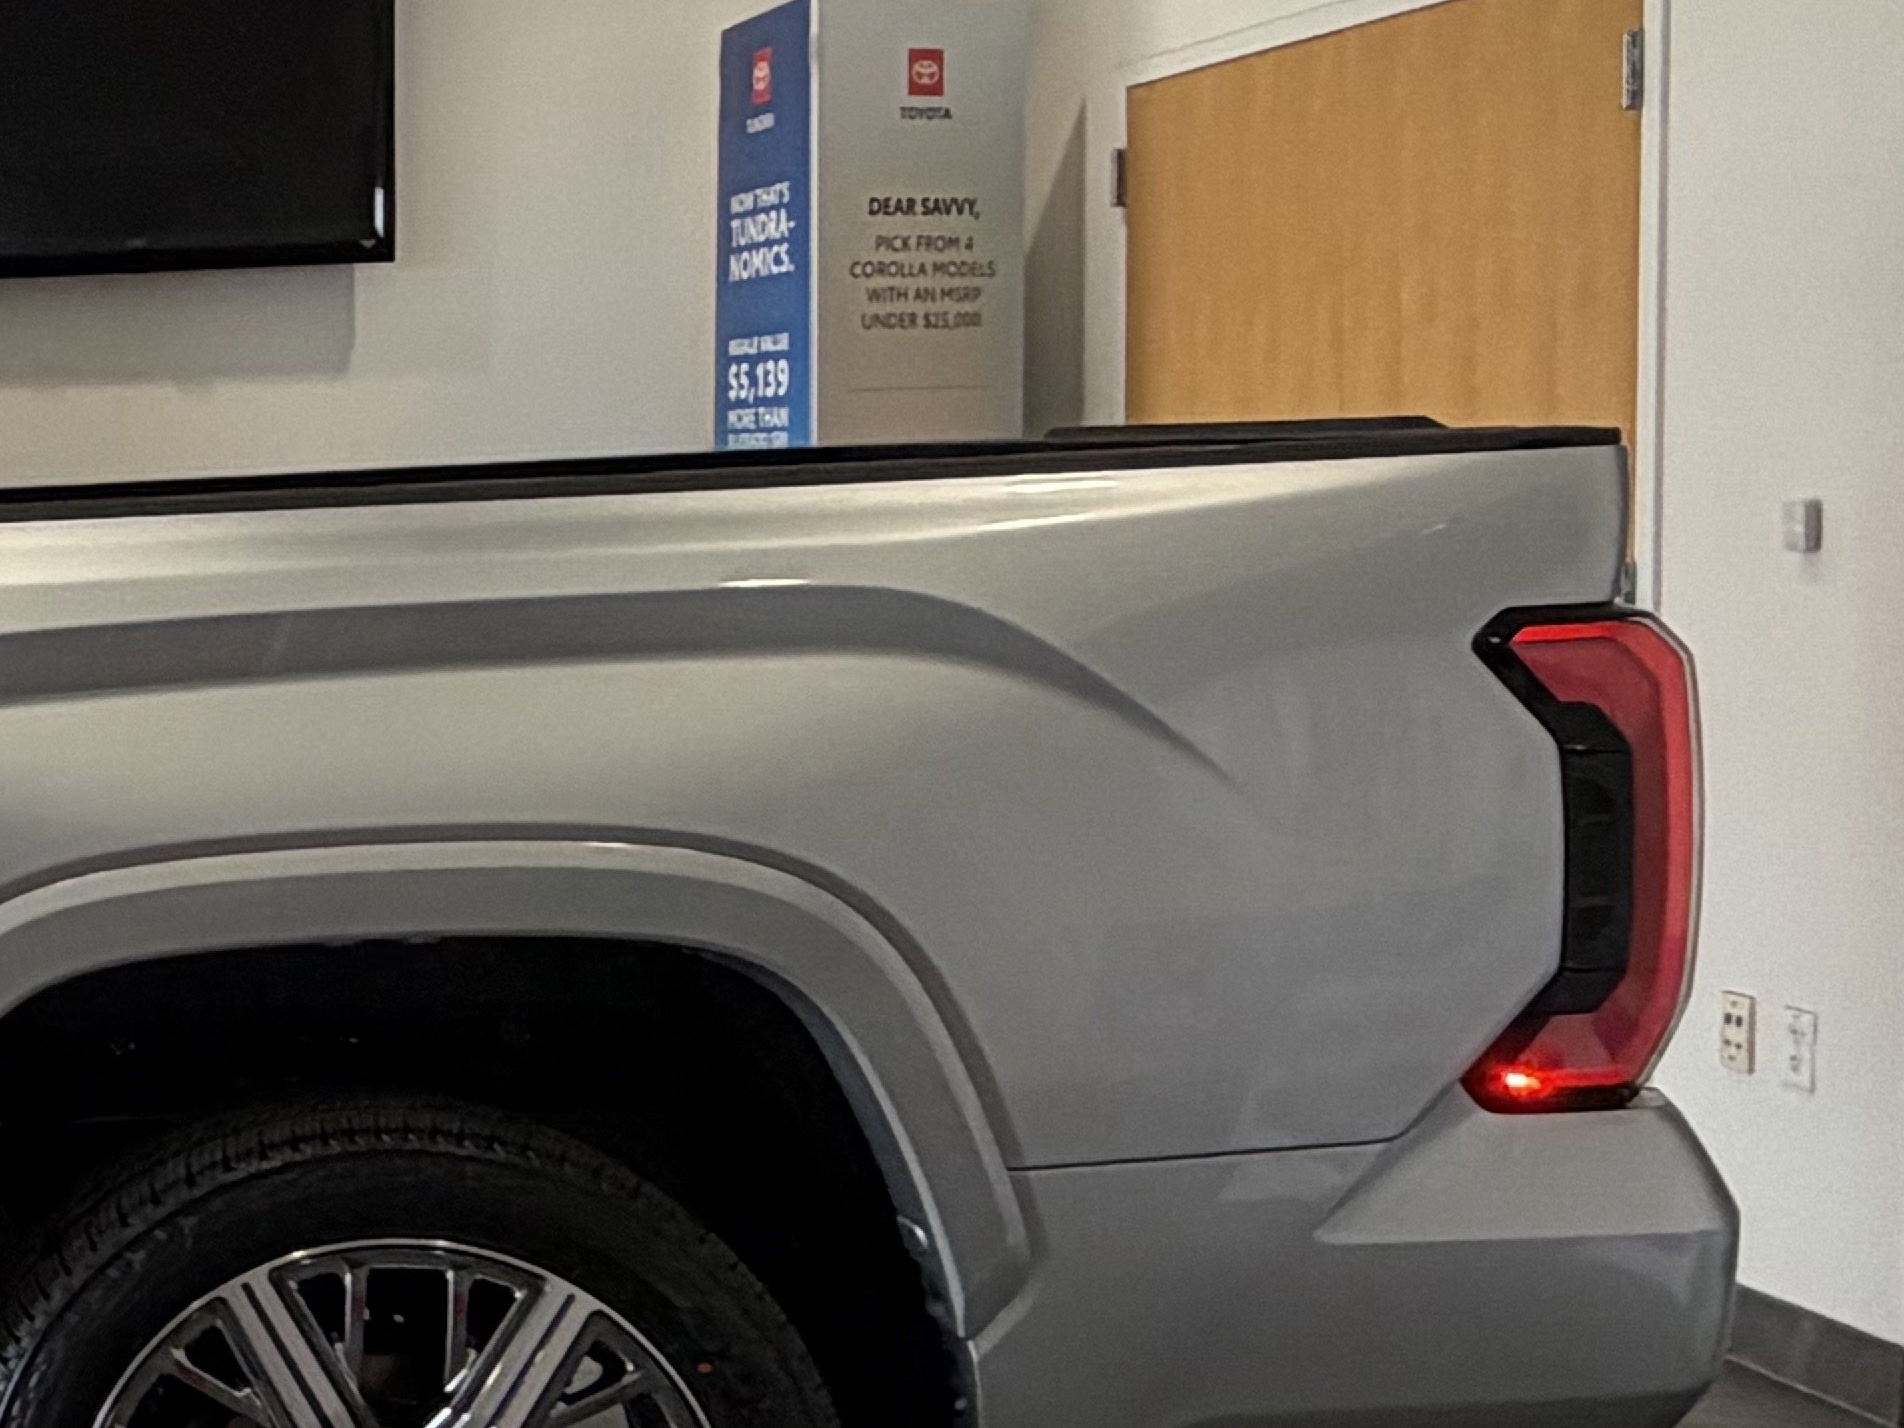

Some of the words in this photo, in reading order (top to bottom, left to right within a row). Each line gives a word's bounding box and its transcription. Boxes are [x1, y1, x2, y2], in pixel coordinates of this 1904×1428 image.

[899, 106, 953, 120] TOYOTA
[868, 196, 917, 217] DEAR
[920, 196, 981, 221] SAVVY,
[730, 208, 796, 248] TUNDRA-
[874, 234, 912, 253] PICK
[915, 234, 961, 253] FROM
[729, 242, 795, 283] NOMICS.
[848, 260, 928, 280] COROLLA
[931, 260, 997, 279] MODELS
[865, 286, 910, 304] WITH
[913, 286, 938, 304] AN
[861, 311, 918, 330] UNDER
[728, 358, 790, 404] $5,139
